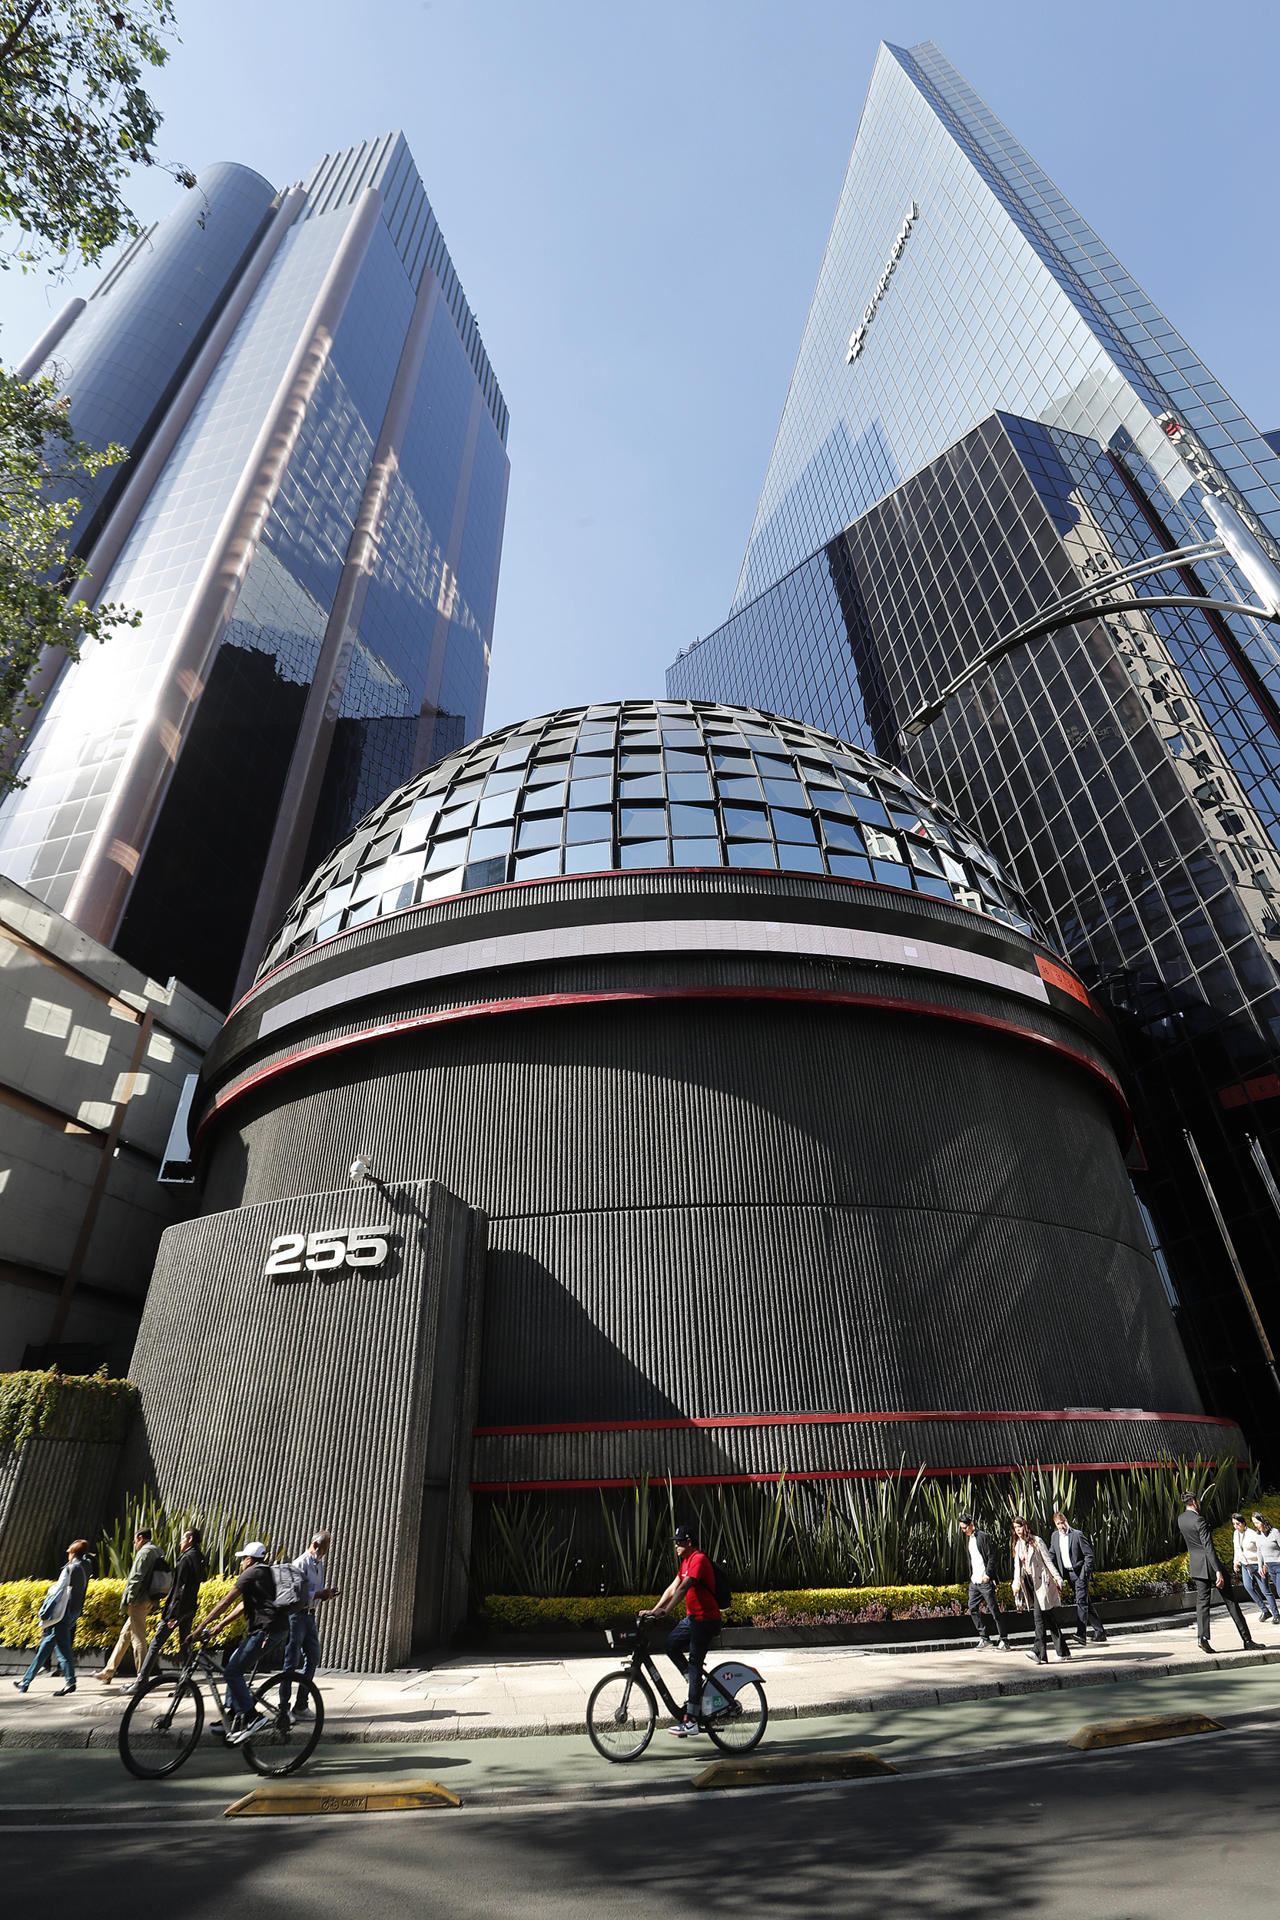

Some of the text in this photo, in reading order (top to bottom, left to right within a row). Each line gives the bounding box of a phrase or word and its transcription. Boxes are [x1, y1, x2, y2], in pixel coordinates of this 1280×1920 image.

[863, 201, 919, 323] GRUPO BMV
[264, 1225, 391, 1275] 255
